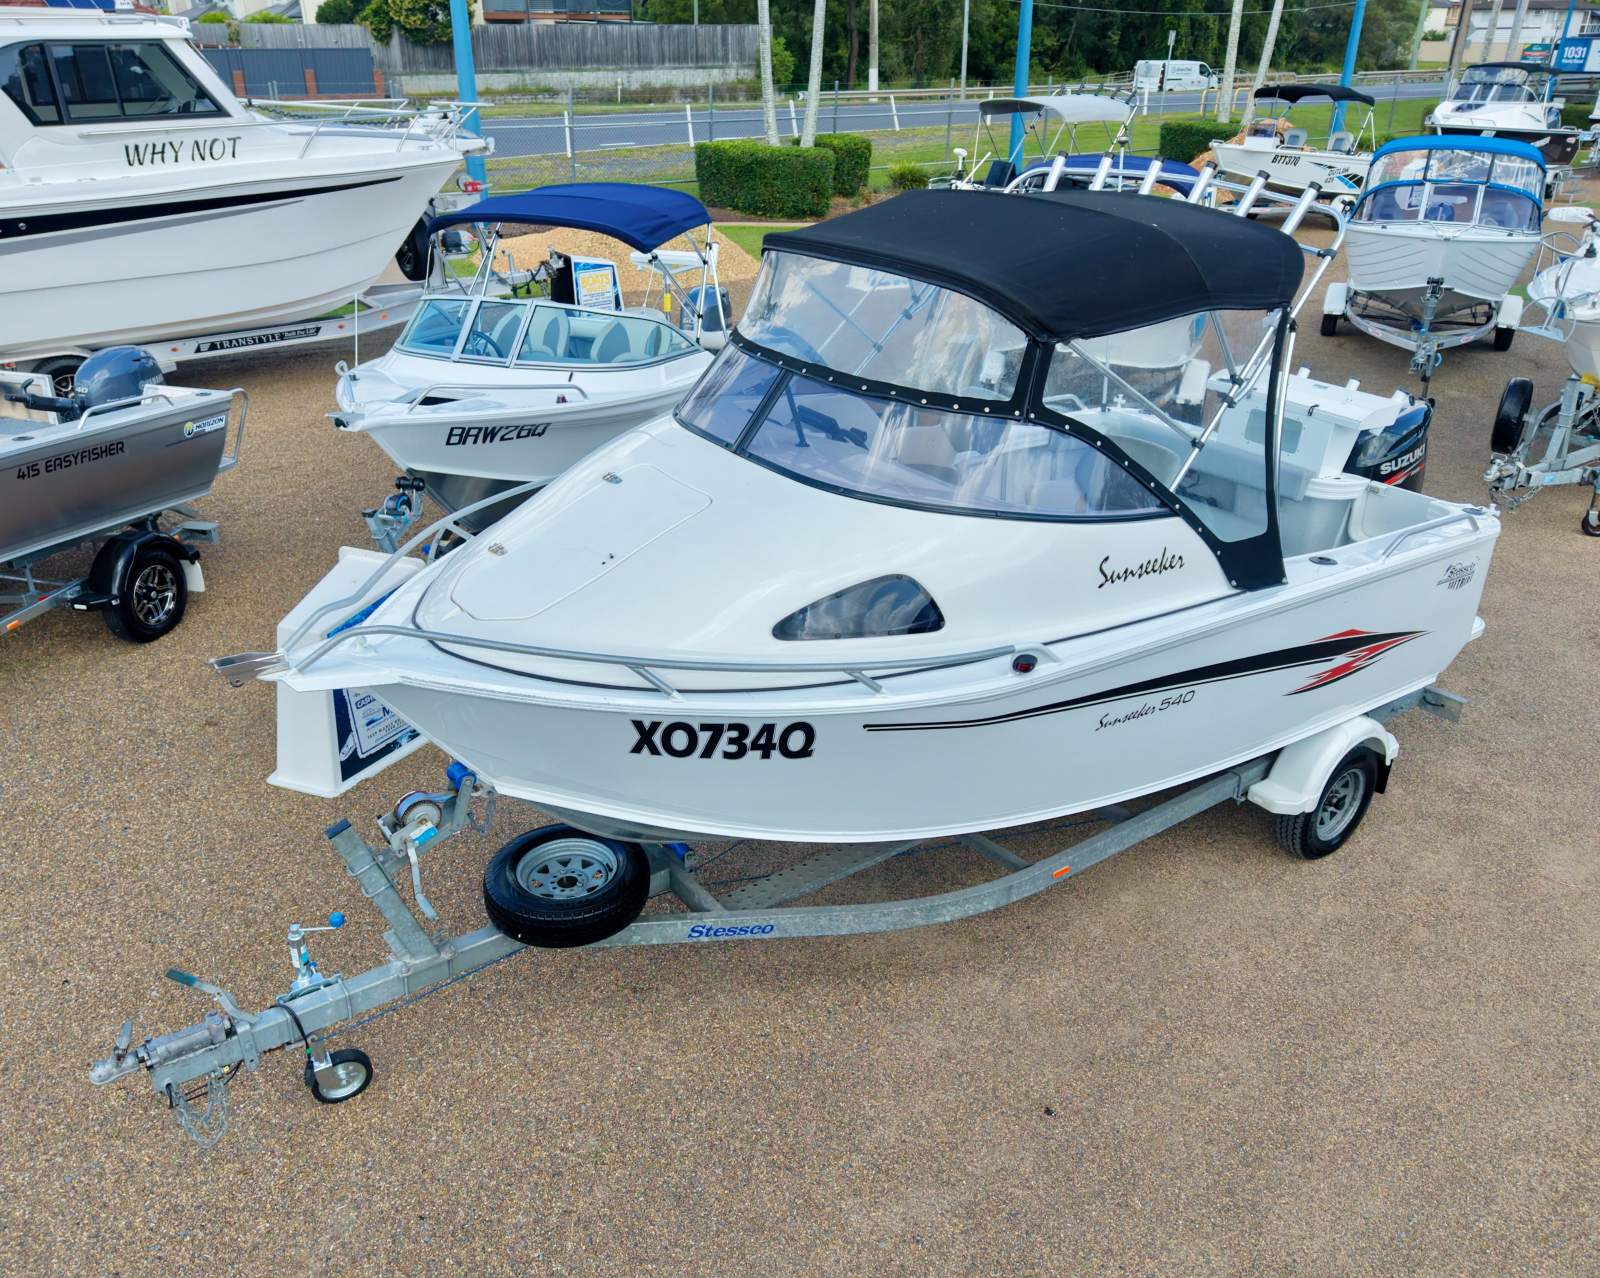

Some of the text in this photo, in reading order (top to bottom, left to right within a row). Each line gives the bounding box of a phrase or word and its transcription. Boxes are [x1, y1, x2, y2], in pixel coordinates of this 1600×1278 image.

[1564, 46, 1588, 59] 1031
[124, 136, 242, 167] WHY NOT
[1271, 154, 1301, 167] BTT370
[215, 333, 281, 350] TRANSTYLE
[194, 416, 225, 430] HORIZON
[16, 440, 125, 480] 415 EASYFISHER
[1380, 442, 1426, 475] SUZUKI
[1098, 546, 1184, 588] Sunseeker
[1095, 690, 1195, 731] Sunseeker 540
[629, 719, 816, 760] XO734Q
[687, 924, 774, 938] Stessco
